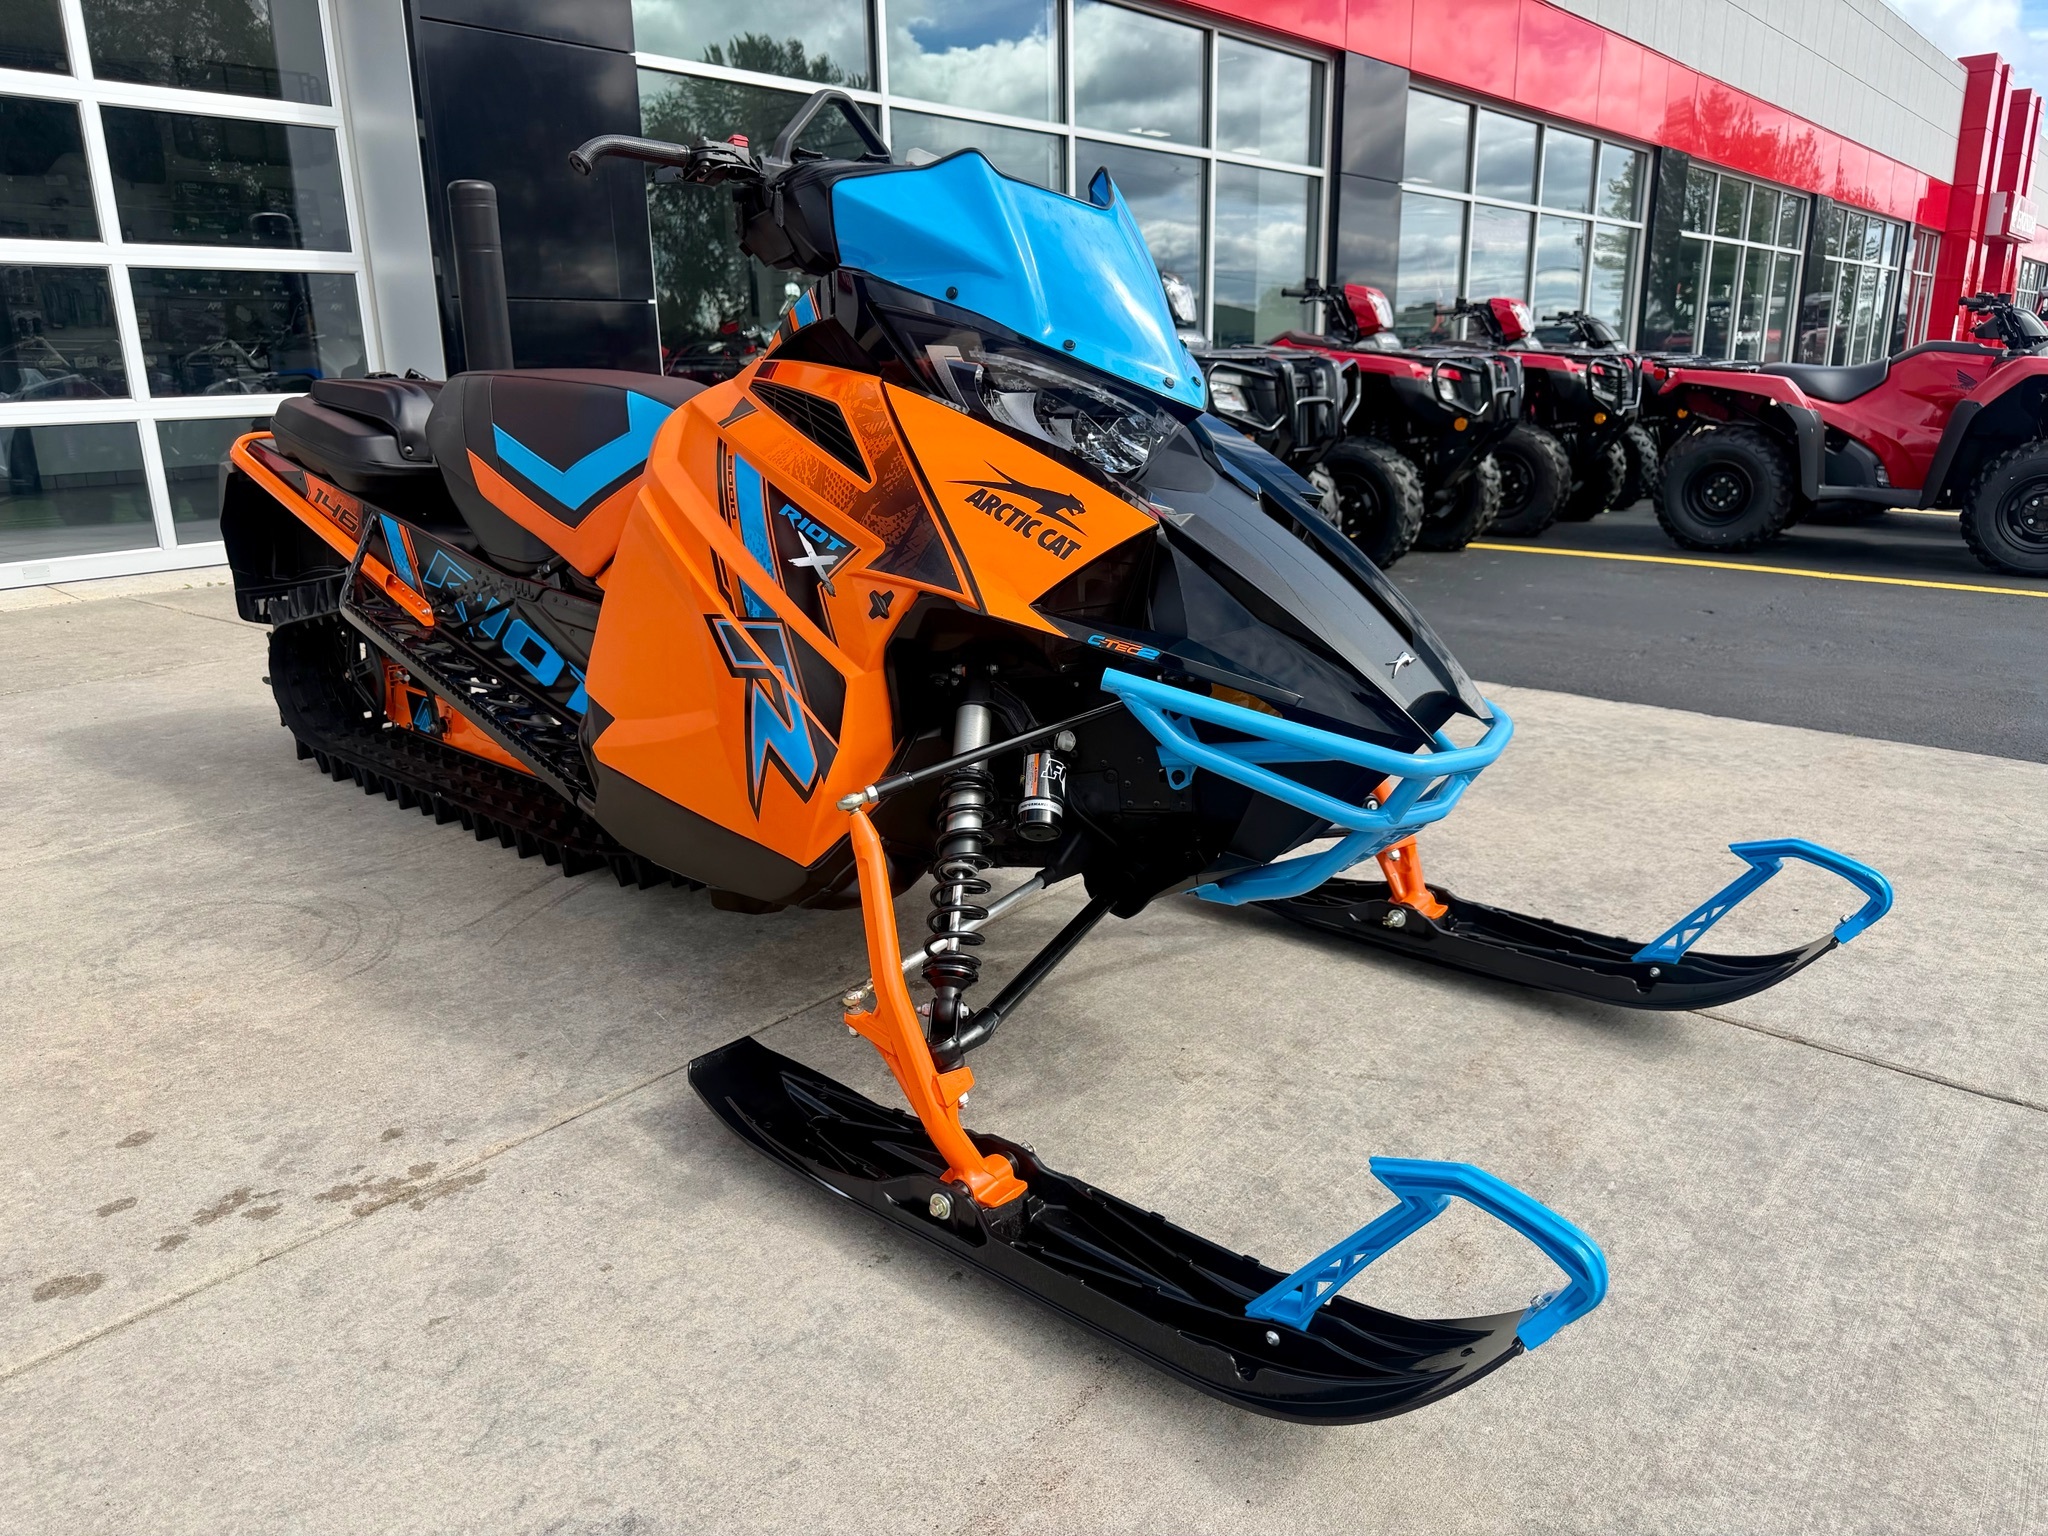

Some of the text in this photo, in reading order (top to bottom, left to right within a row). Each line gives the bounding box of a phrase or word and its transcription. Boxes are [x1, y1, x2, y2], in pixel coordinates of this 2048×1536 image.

[314, 487, 359, 534] 146
[778, 503, 848, 551] RIOT
[964, 488, 1082, 561] ARCTIC CAT
[1087, 634, 1161, 661] C-TEC2
